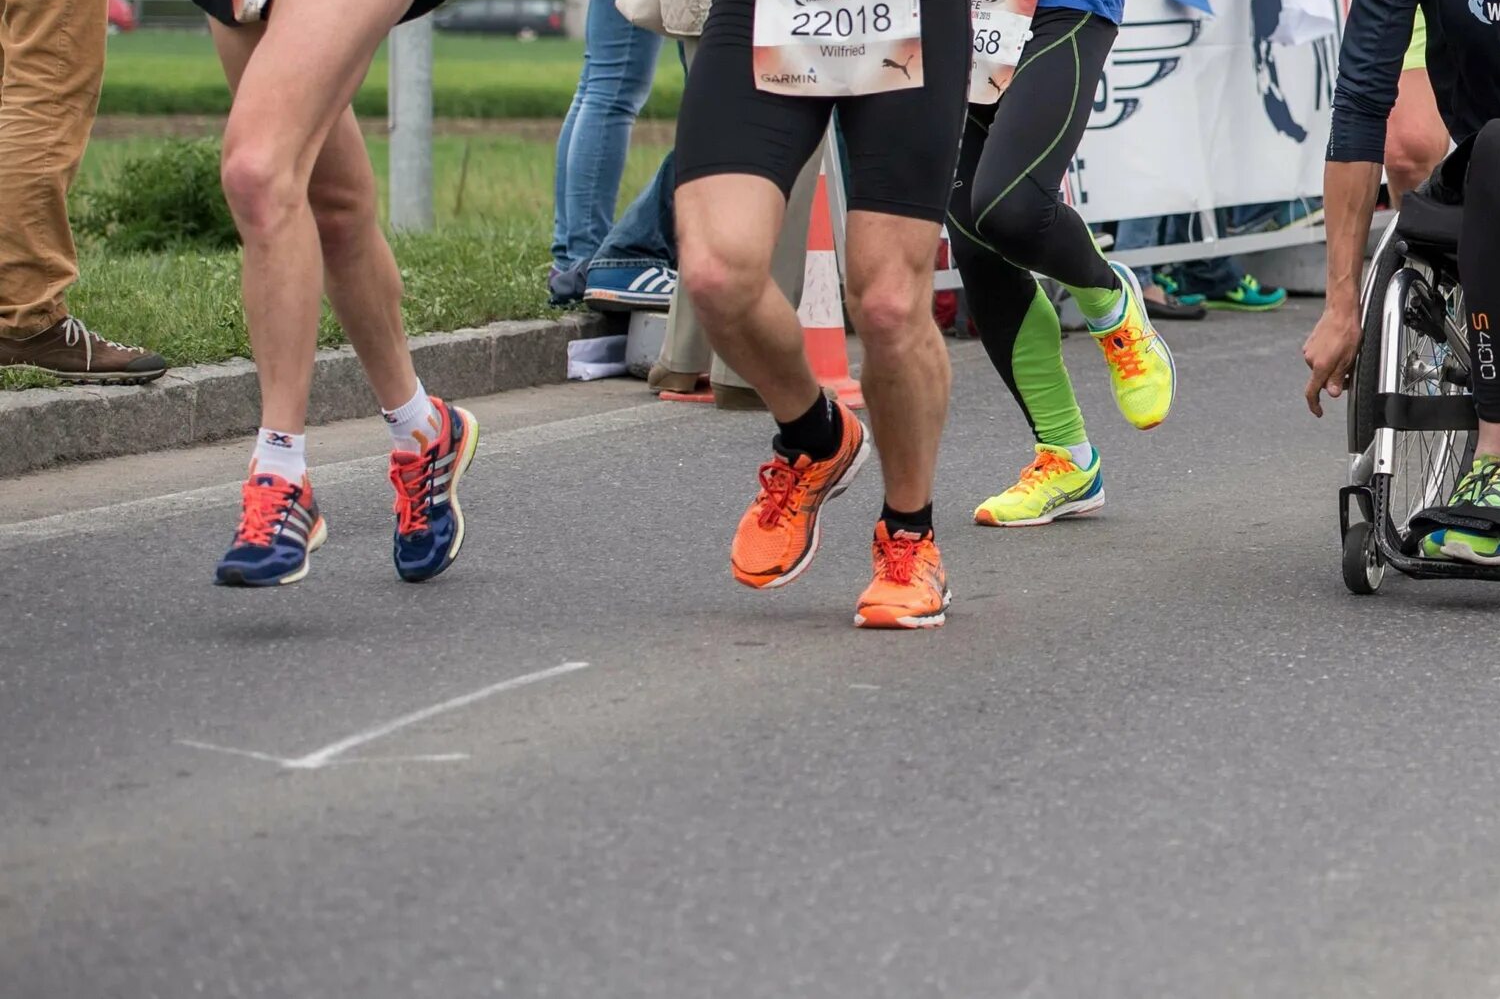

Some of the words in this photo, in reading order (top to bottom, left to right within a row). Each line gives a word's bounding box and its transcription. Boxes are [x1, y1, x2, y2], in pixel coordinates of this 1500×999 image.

[791, 2, 892, 37] 22018
[820, 44, 866, 57] Wilfried
[974, 29, 1001, 55] 58
[761, 73, 818, 84] GARMIN
